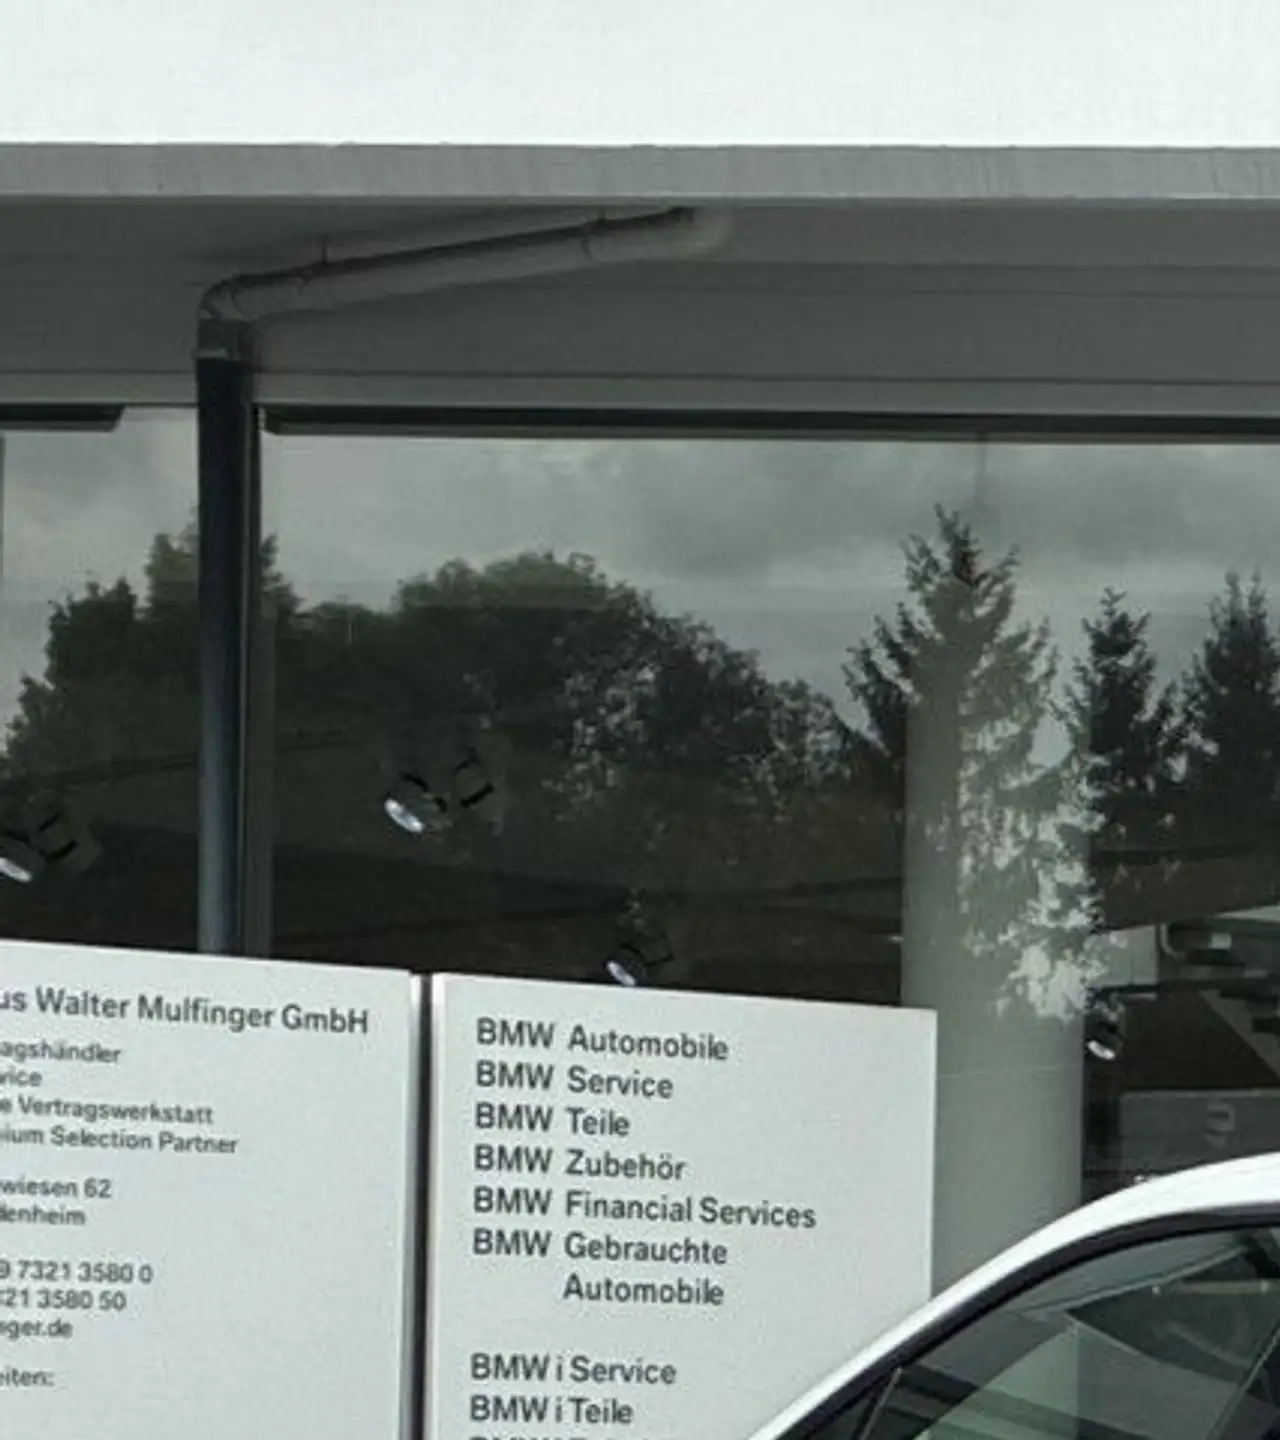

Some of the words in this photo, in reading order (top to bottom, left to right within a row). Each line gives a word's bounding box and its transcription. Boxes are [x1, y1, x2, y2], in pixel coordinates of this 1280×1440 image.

[36, 985, 132, 1019] Walter
[137, 993, 274, 1034] Mulfinger
[281, 1003, 369, 1035] GmbH
[476, 1015, 555, 1049] BMW
[566, 1022, 730, 1061] Automobile
[475, 1058, 554, 1090] BMW
[566, 1064, 675, 1099] Service
[18, 1095, 214, 1125] Vertragswerkstatt
[474, 1100, 553, 1134] BMW
[566, 1106, 632, 1138] Teile
[50, 1124, 153, 1152] Selection
[158, 1130, 239, 1155] Partner
[473, 1143, 553, 1175] BMW
[565, 1148, 688, 1183] Zubehör
[83, 1177, 113, 1200] 62
[472, 1185, 552, 1218] BMW
[565, 1190, 693, 1224] Financial
[699, 1195, 818, 1231] Services
[472, 1227, 552, 1260] BMW
[563, 1231, 729, 1266] Gebrauchte
[17, 1260, 72, 1282] 7321
[77, 1261, 134, 1284] 3580
[138, 1263, 154, 1285] 0
[563, 1272, 725, 1307] Automobile
[36, 1289, 94, 1311] 3580
[98, 1291, 127, 1312] 50
[470, 1353, 550, 1382] BMW
[555, 1354, 565, 1382] i
[569, 1354, 678, 1386] Service
[469, 1394, 549, 1424] BMW
[554, 1395, 564, 1424] i
[568, 1396, 634, 1426] Teile
